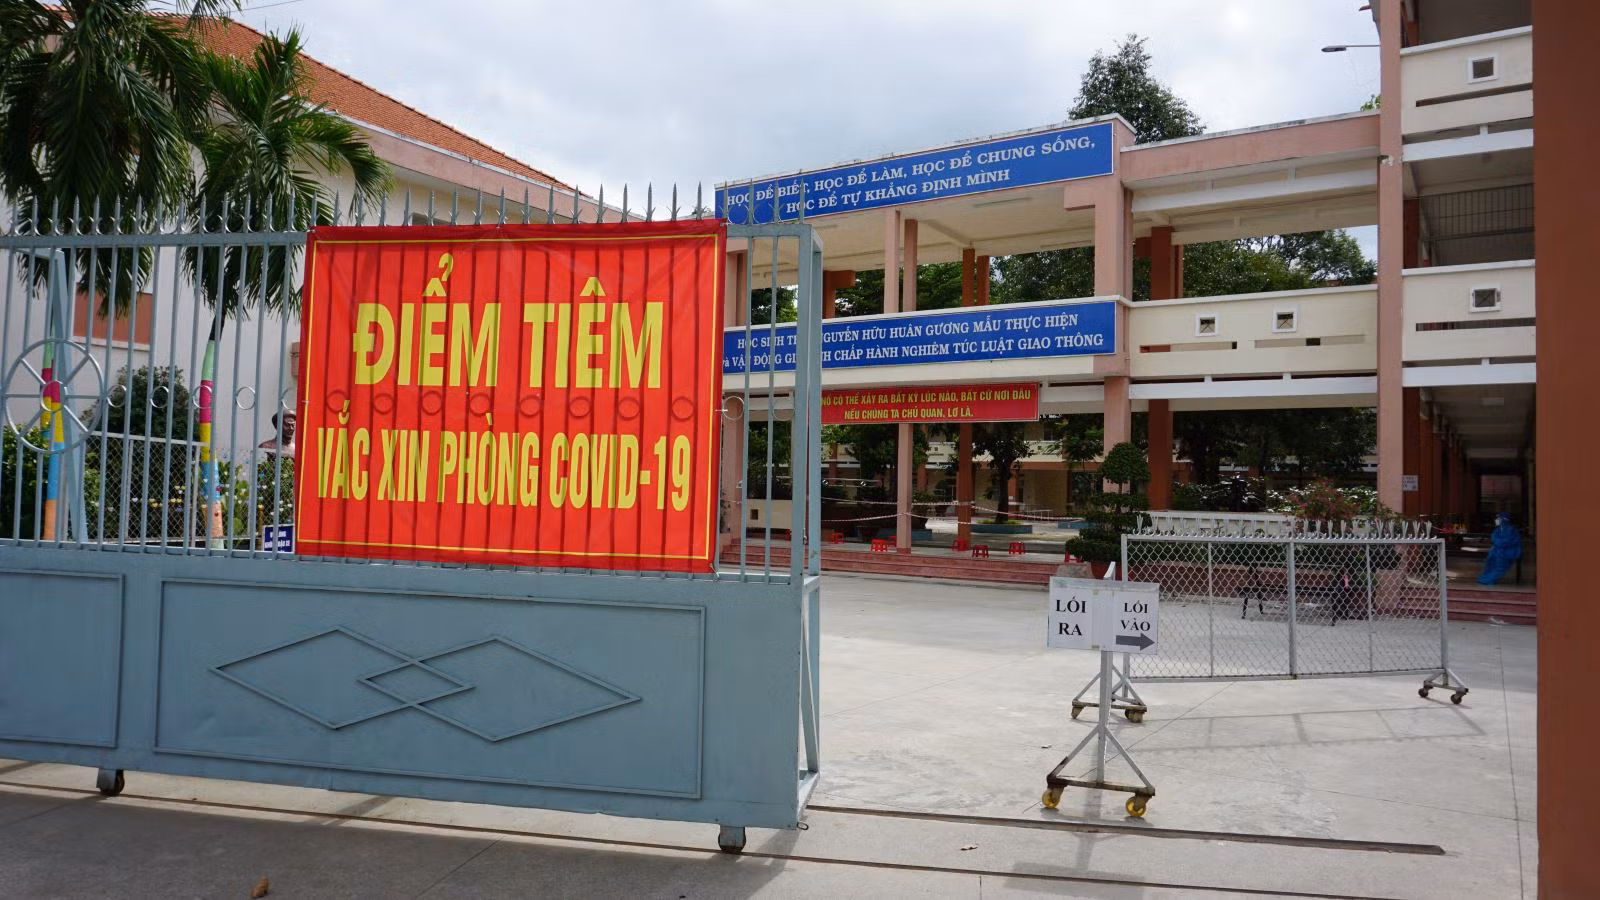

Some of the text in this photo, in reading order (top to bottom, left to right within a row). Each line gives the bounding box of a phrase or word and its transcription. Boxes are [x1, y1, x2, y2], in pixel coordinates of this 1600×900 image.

[756, 184, 774, 201] ĐỂ
[814, 177, 843, 192] HỌC
[847, 168, 867, 185] ĐỂ
[872, 166, 908, 182] LÀM,
[912, 160, 945, 176] HỌC
[950, 150, 972, 169] ĐỂ
[977, 145, 1036, 164] CHUNG
[1041, 135, 1095, 155] SỐNG,
[818, 190, 838, 208] ĐỂ
[841, 190, 862, 206] TỰ
[865, 182, 917, 202] KHẲNG
[921, 177, 961, 194] ĐỊNH
[966, 169, 1010, 185] MÌNH
[353, 252, 664, 388] ĐIỂM TIÊM
[822, 325, 859, 343] GUYỄN
[862, 326, 887, 340] HỮU
[890, 323, 922, 338] HUÂN
[925, 321, 969, 336] GƯƠNG
[973, 315, 1001, 333] MẪU
[1005, 315, 1041, 333] THỰC
[1044, 311, 1078, 330] HIỆN
[834, 343, 863, 361] CHẤP
[866, 344, 898, 359] HÀNH
[901, 341, 949, 357] NGHIÊM
[953, 338, 977, 354] TÚC
[980, 337, 1014, 355] LUẬT
[1018, 336, 1051, 350] GIAO
[1055, 331, 1104, 348] THÔNG
[878, 394, 889, 404] RA
[994, 389, 1010, 401] NƠI
[844, 407, 860, 420] NẾU
[862, 406, 889, 419] CHÚNG
[891, 408, 900, 418] TA
[318, 400, 691, 511] VẮC XIN PHÒNG COVID-19
[1058, 622, 1083, 636] RA
[1120, 617, 1151, 632] VÀO
